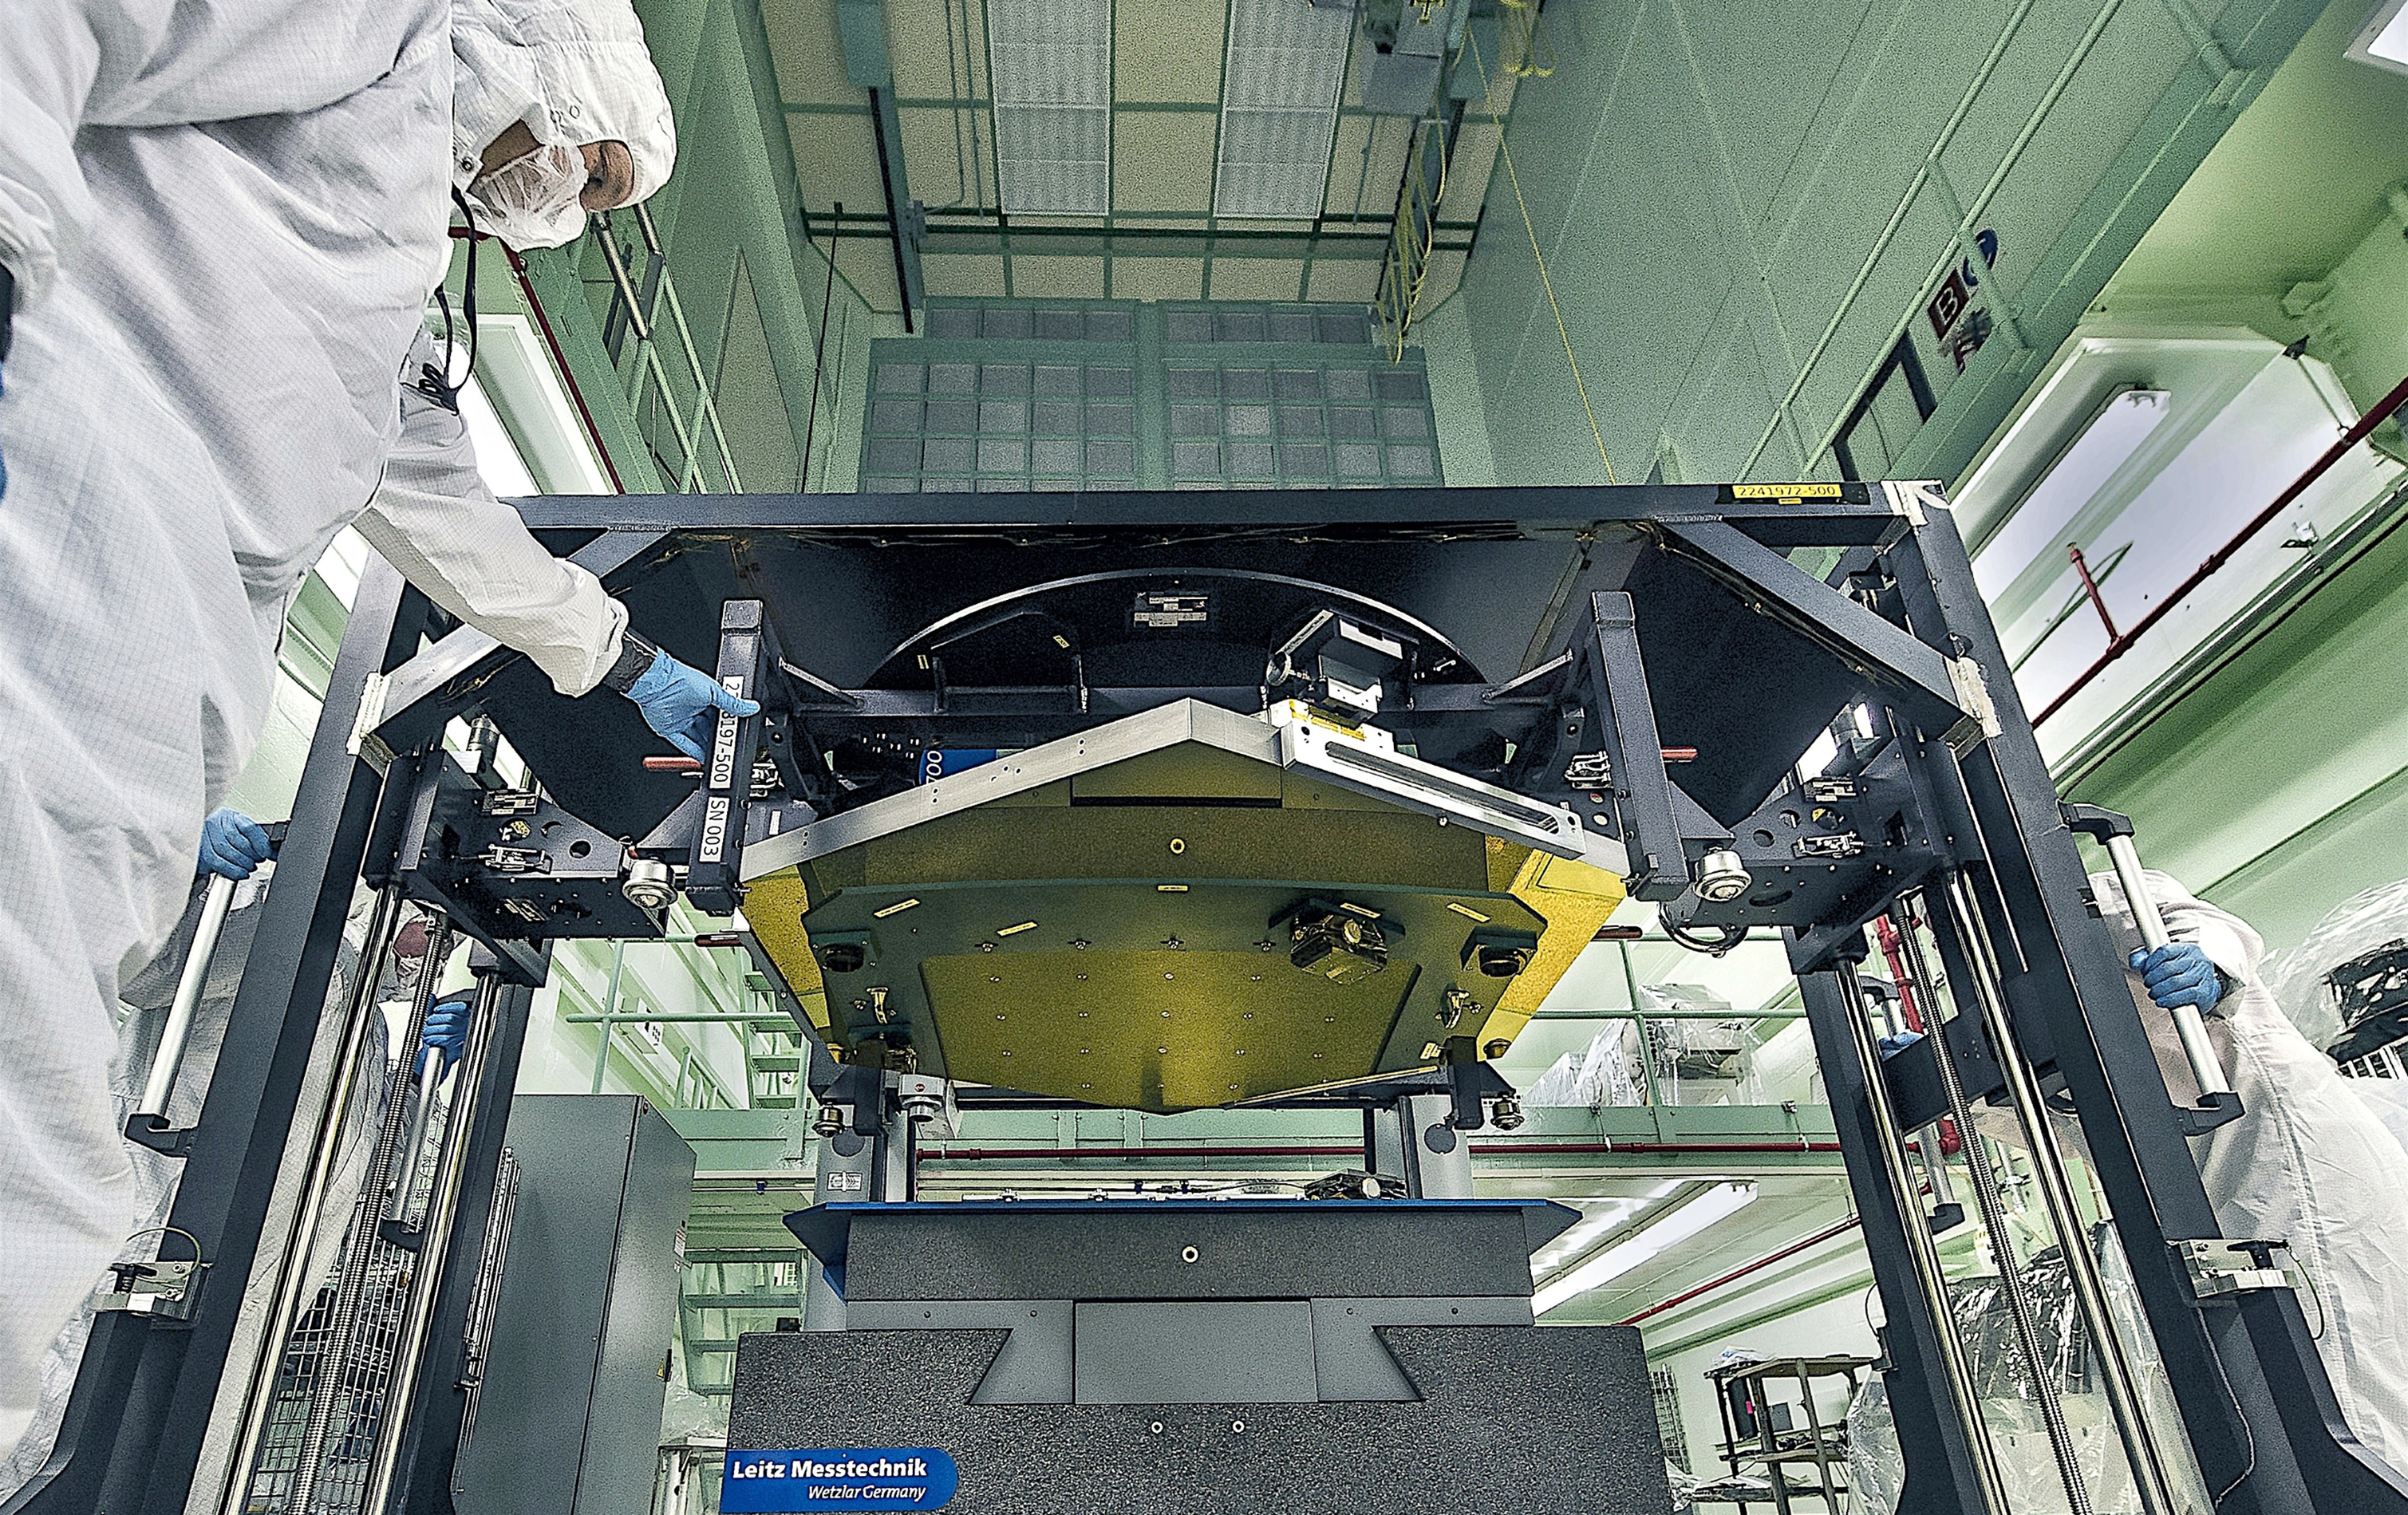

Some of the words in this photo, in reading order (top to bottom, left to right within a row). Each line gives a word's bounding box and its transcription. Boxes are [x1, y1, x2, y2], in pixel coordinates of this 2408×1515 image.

[1936, 286, 1958, 325] B
[1739, 486, 1836, 496] 2241972-500
[713, 683, 740, 782] 28197-500
[709, 800, 725, 820] SN
[703, 826, 722, 856] 003
[732, 1461, 785, 1478] Leitz
[791, 1458, 927, 1478] Messtechnik
[808, 1485, 860, 1499] Wetzlar
[863, 1484, 926, 1502] Germany
